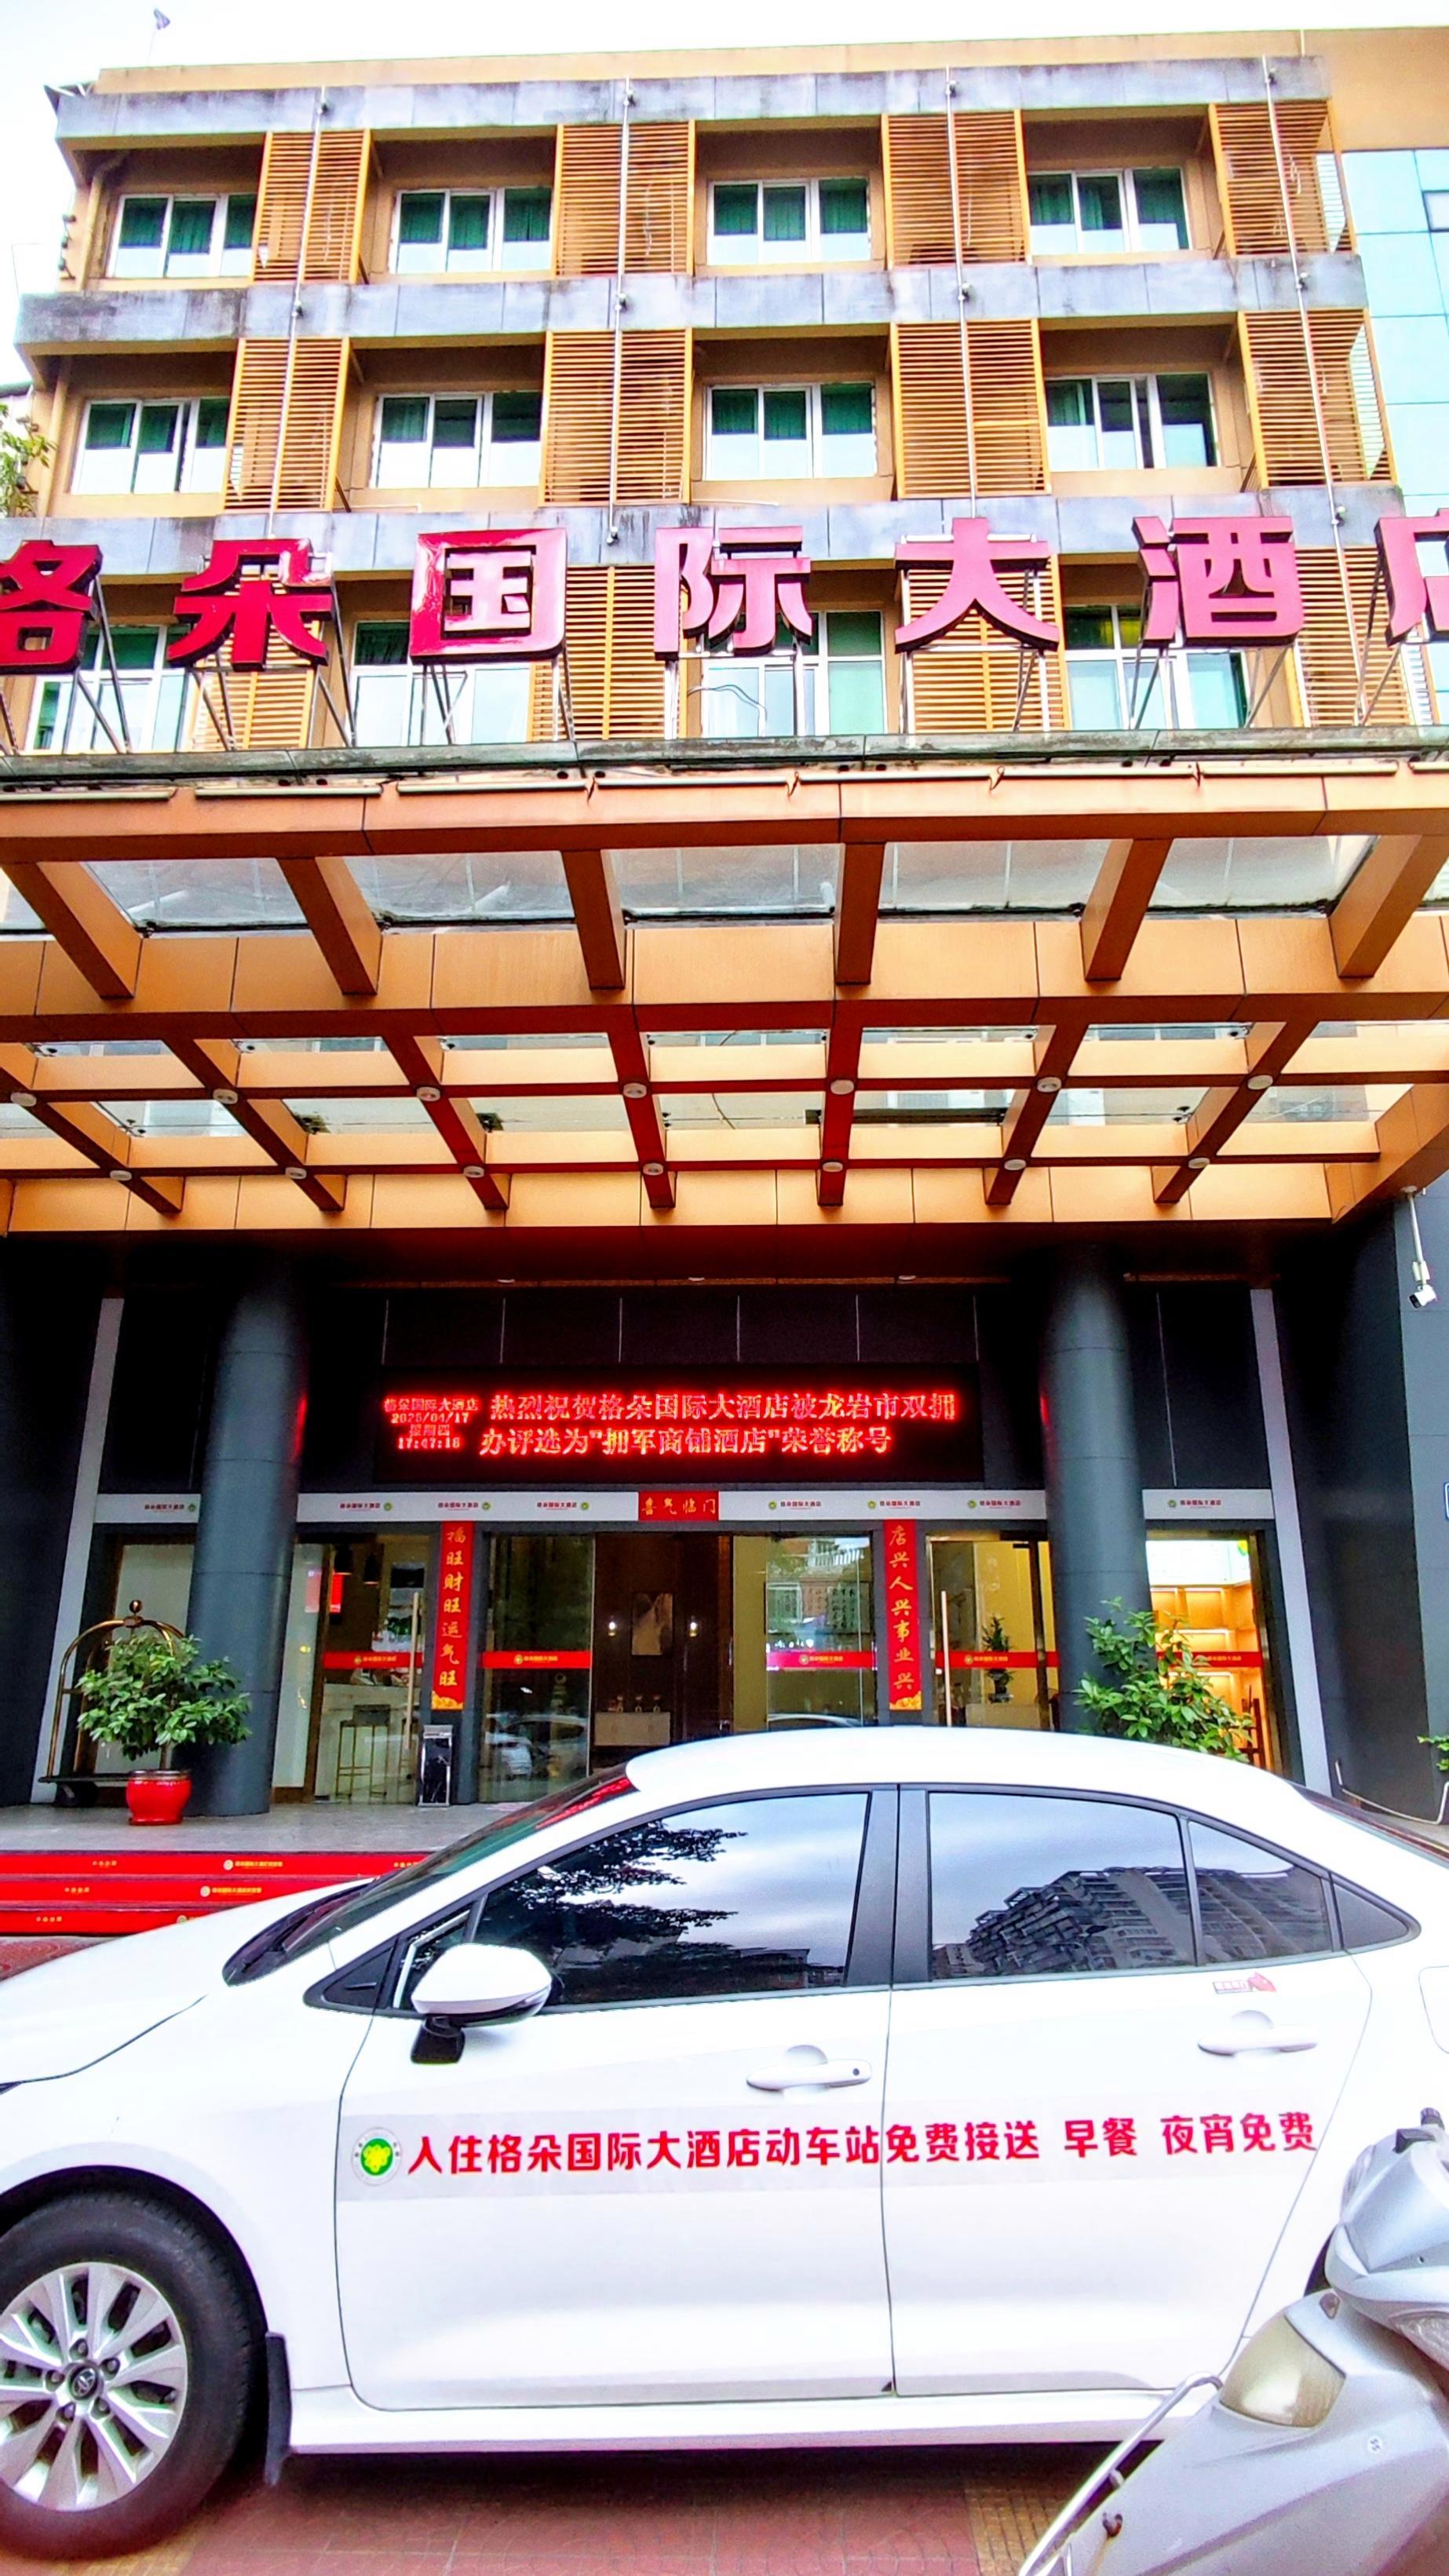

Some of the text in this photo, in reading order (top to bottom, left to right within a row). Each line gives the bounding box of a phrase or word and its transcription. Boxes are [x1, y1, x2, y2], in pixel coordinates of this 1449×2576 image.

[491, 1392, 955, 1421] 热烈祝贺格朵国际大酒店被龙岩市双拥
[642, 1497, 716, 1516] 喜气临门
[439, 1527, 467, 1687] 福旺财旺运气旺
[889, 1525, 914, 1690] 店兴人兴事业兴
[407, 2111, 1317, 2175] 入住格朵国际大酒店动车站免费接送 早餐 夜宵免费
